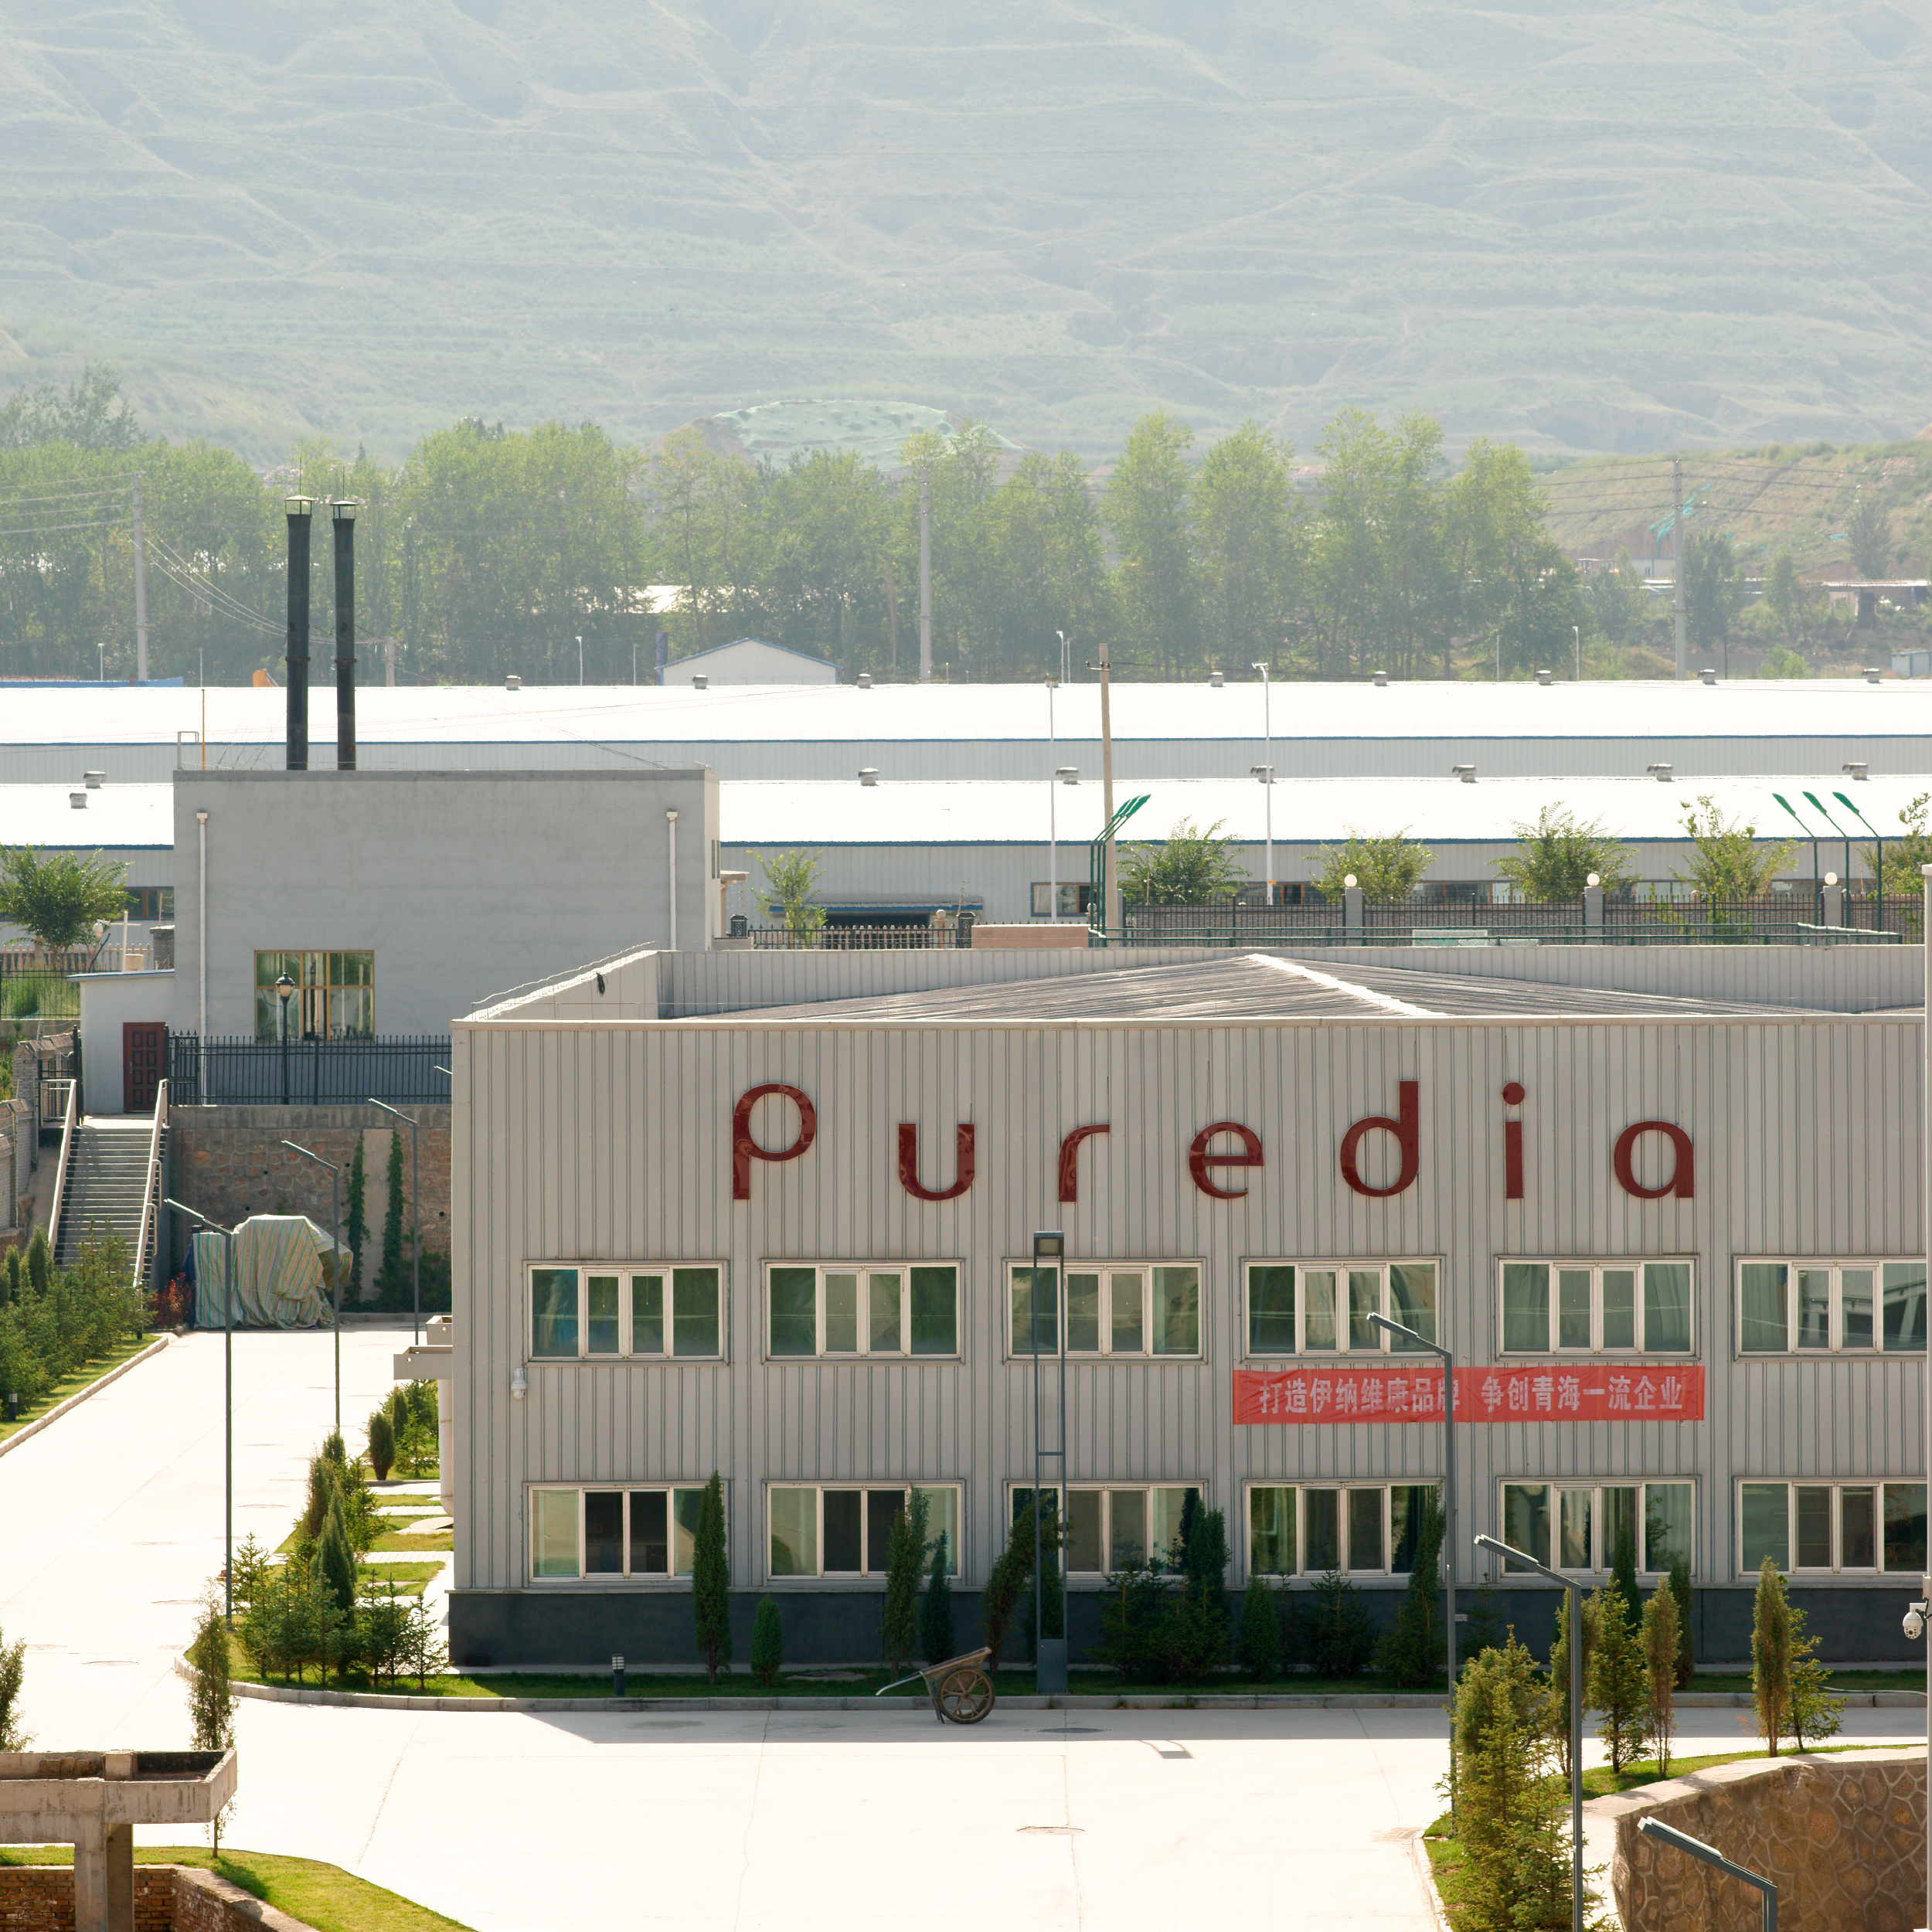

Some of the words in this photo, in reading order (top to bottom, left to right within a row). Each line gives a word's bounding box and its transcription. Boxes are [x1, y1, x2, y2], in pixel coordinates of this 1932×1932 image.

[732, 1081, 1695, 1202] Puredia
[1259, 1377, 1461, 1414] 打造伊纳维康品牌
[1481, 1375, 1682, 1413] 争创青海一流企业
